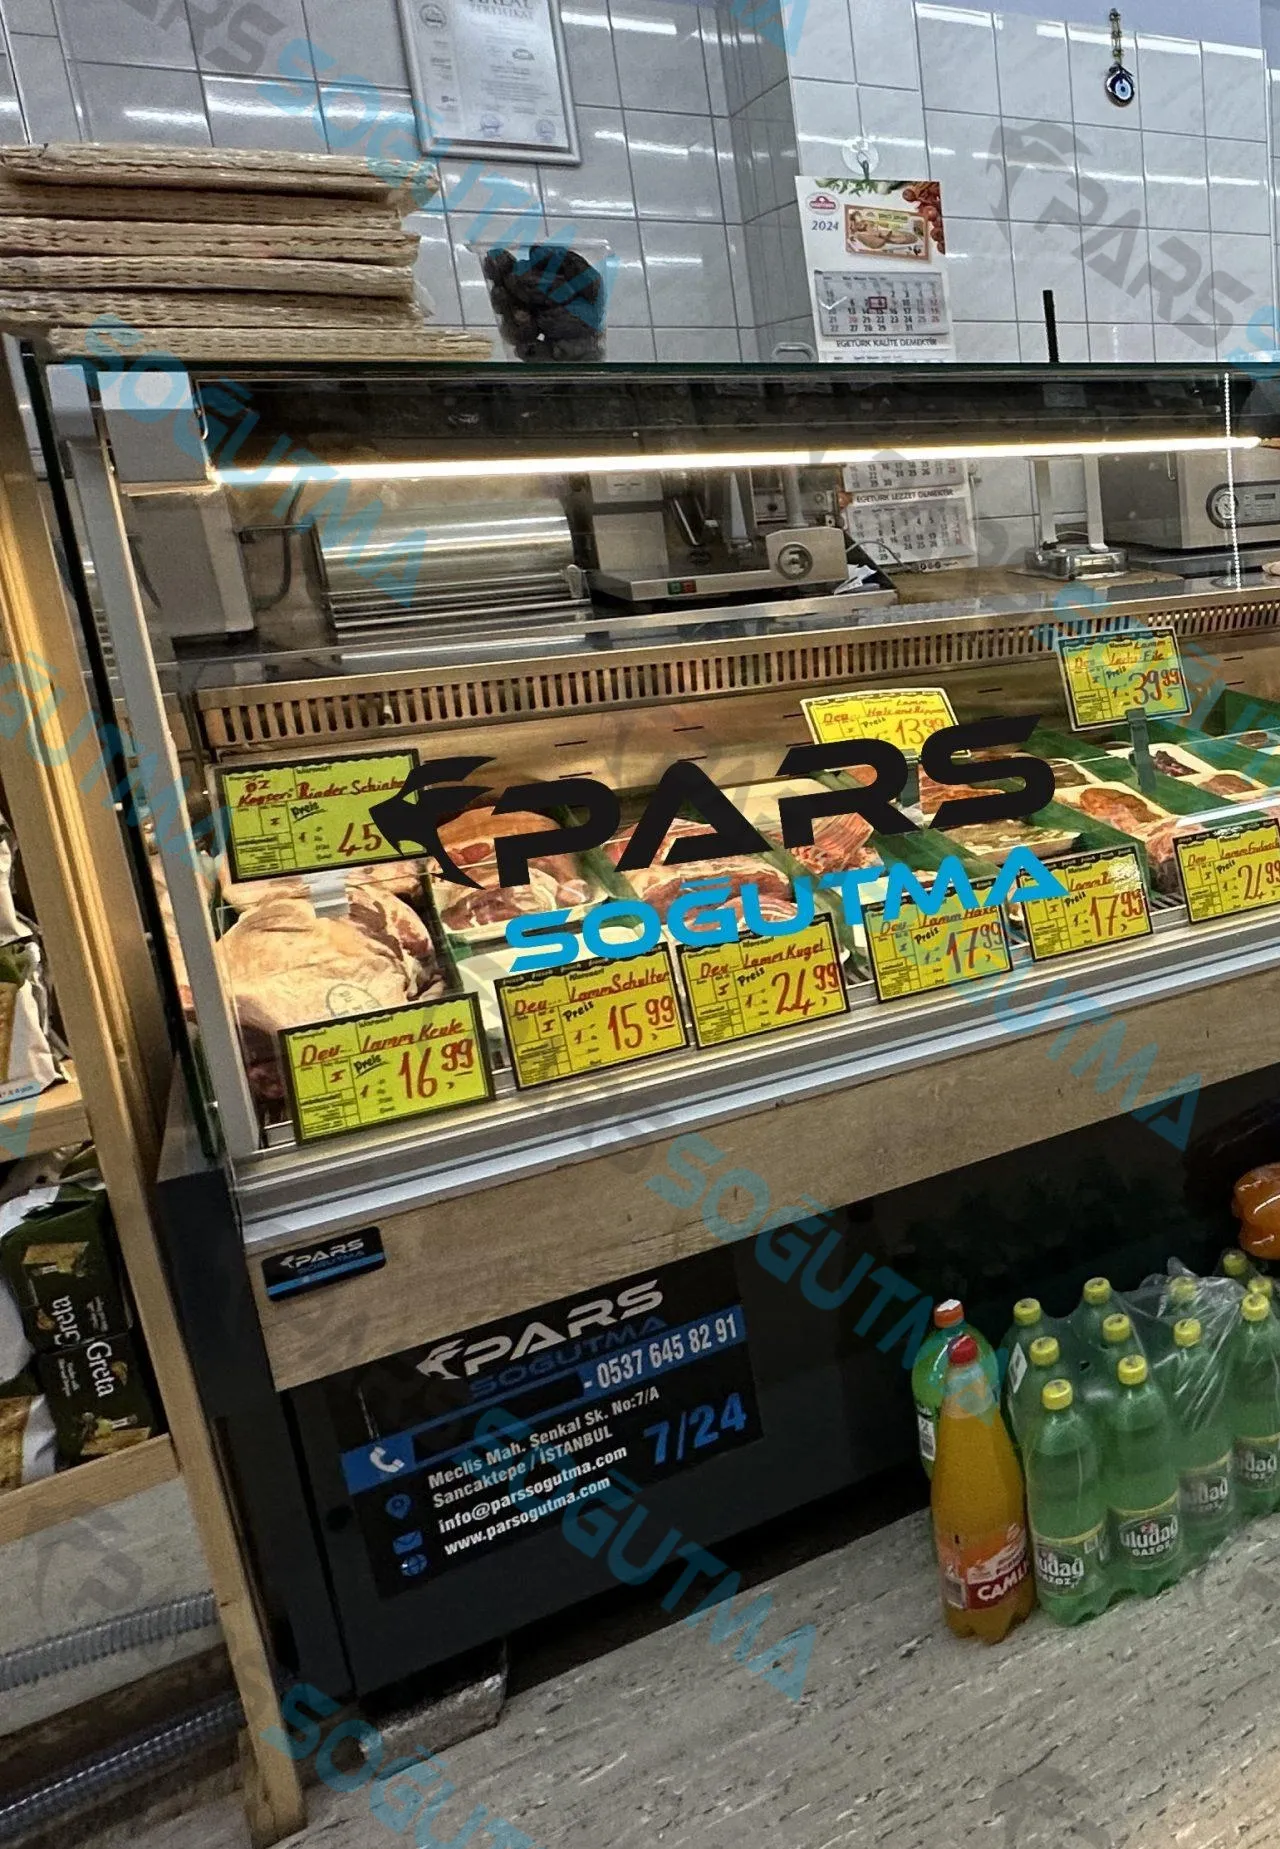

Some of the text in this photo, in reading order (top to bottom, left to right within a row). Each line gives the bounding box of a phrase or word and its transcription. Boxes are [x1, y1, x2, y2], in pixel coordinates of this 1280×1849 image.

[812, 221, 838, 230] 2024
[295, 1238, 364, 1268] PARS
[463, 1280, 663, 1376] PARS
[596, 1349, 643, 1389] 0537
[649, 1334, 685, 1368] 645
[689, 1324, 712, 1350] 82
[715, 1313, 737, 1343] 91
[86, 1341, 115, 1398] Greta
[428, 1457, 482, 1490] Meclis
[486, 1440, 526, 1466] Mah.
[584, 1410, 609, 1427] Sk.
[612, 1385, 660, 1415] No:7/A
[643, 1392, 747, 1466] 7/24
[432, 1462, 526, 1508] Sancaktepe
[439, 1446, 627, 1534] info@parssogutma.com
[444, 1476, 611, 1556] www.parsogutma.com
